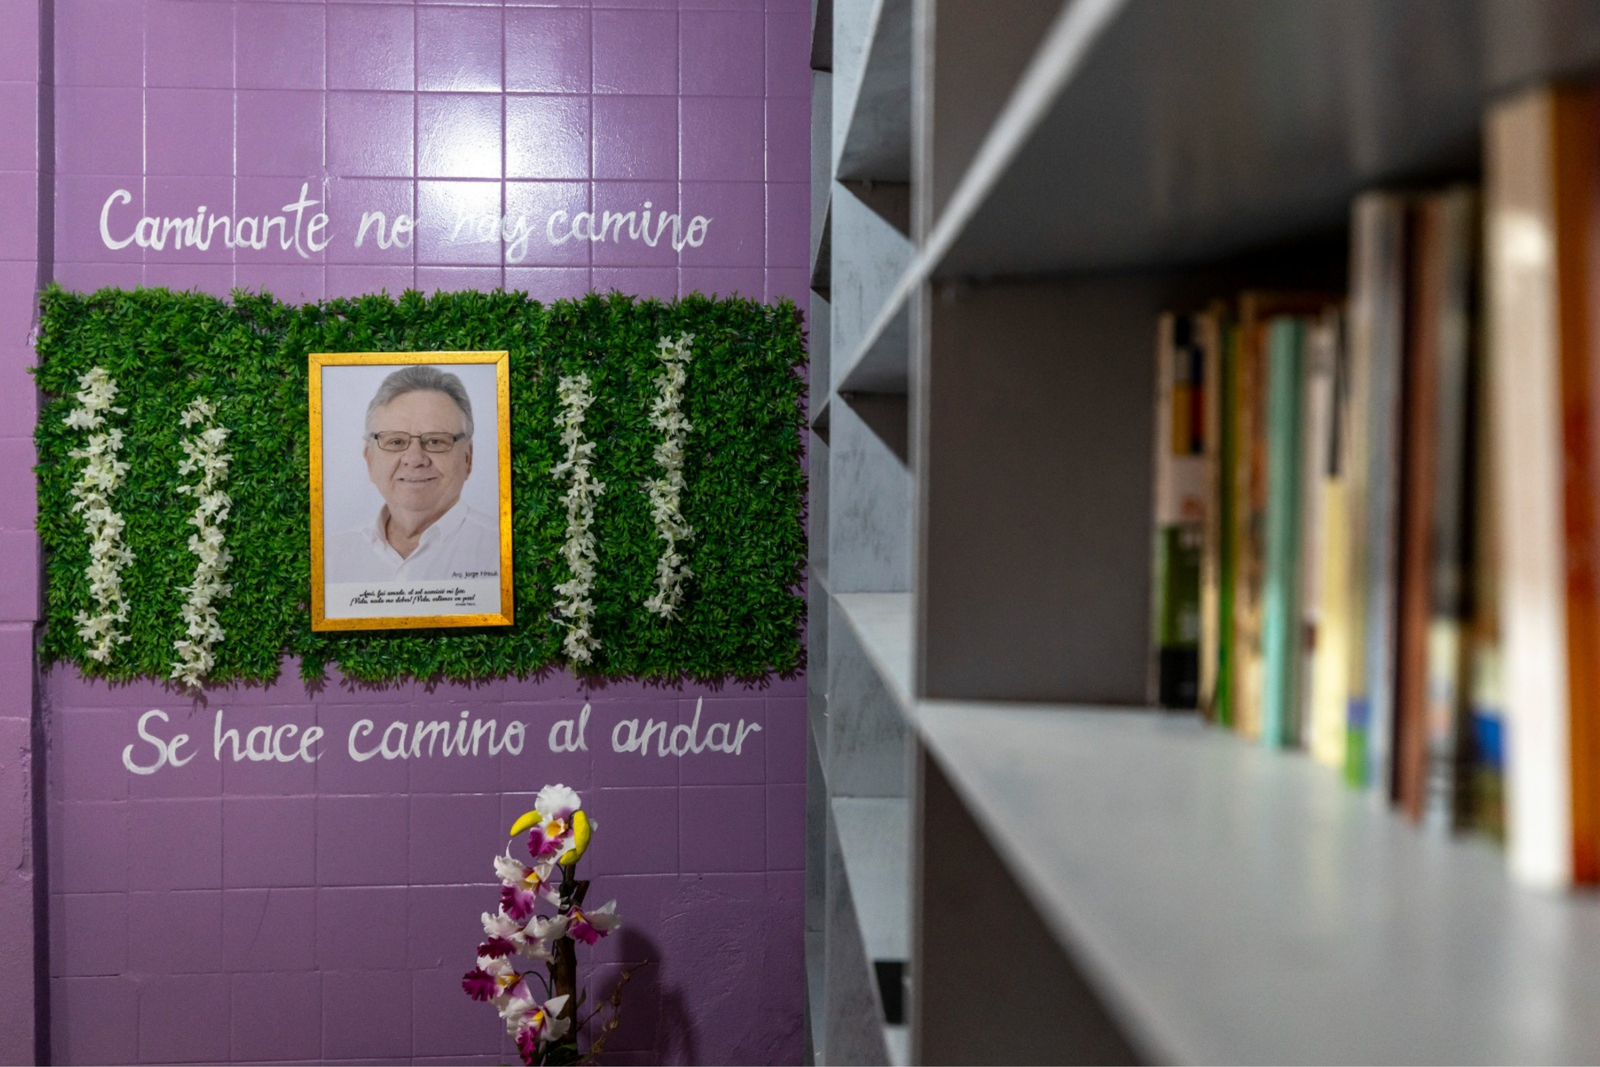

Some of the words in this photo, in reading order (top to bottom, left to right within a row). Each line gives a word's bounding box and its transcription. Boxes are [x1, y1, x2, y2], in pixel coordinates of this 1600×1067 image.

[99, 182, 334, 259] Caminante
[354, 210, 419, 250] no
[449, 198, 536, 263] hay
[546, 200, 713, 252] camino
[122, 709, 199, 775] Se
[213, 709, 327, 763] hace
[348, 710, 529, 762] camino
[548, 703, 591, 752] al
[611, 696, 763, 757] andar
